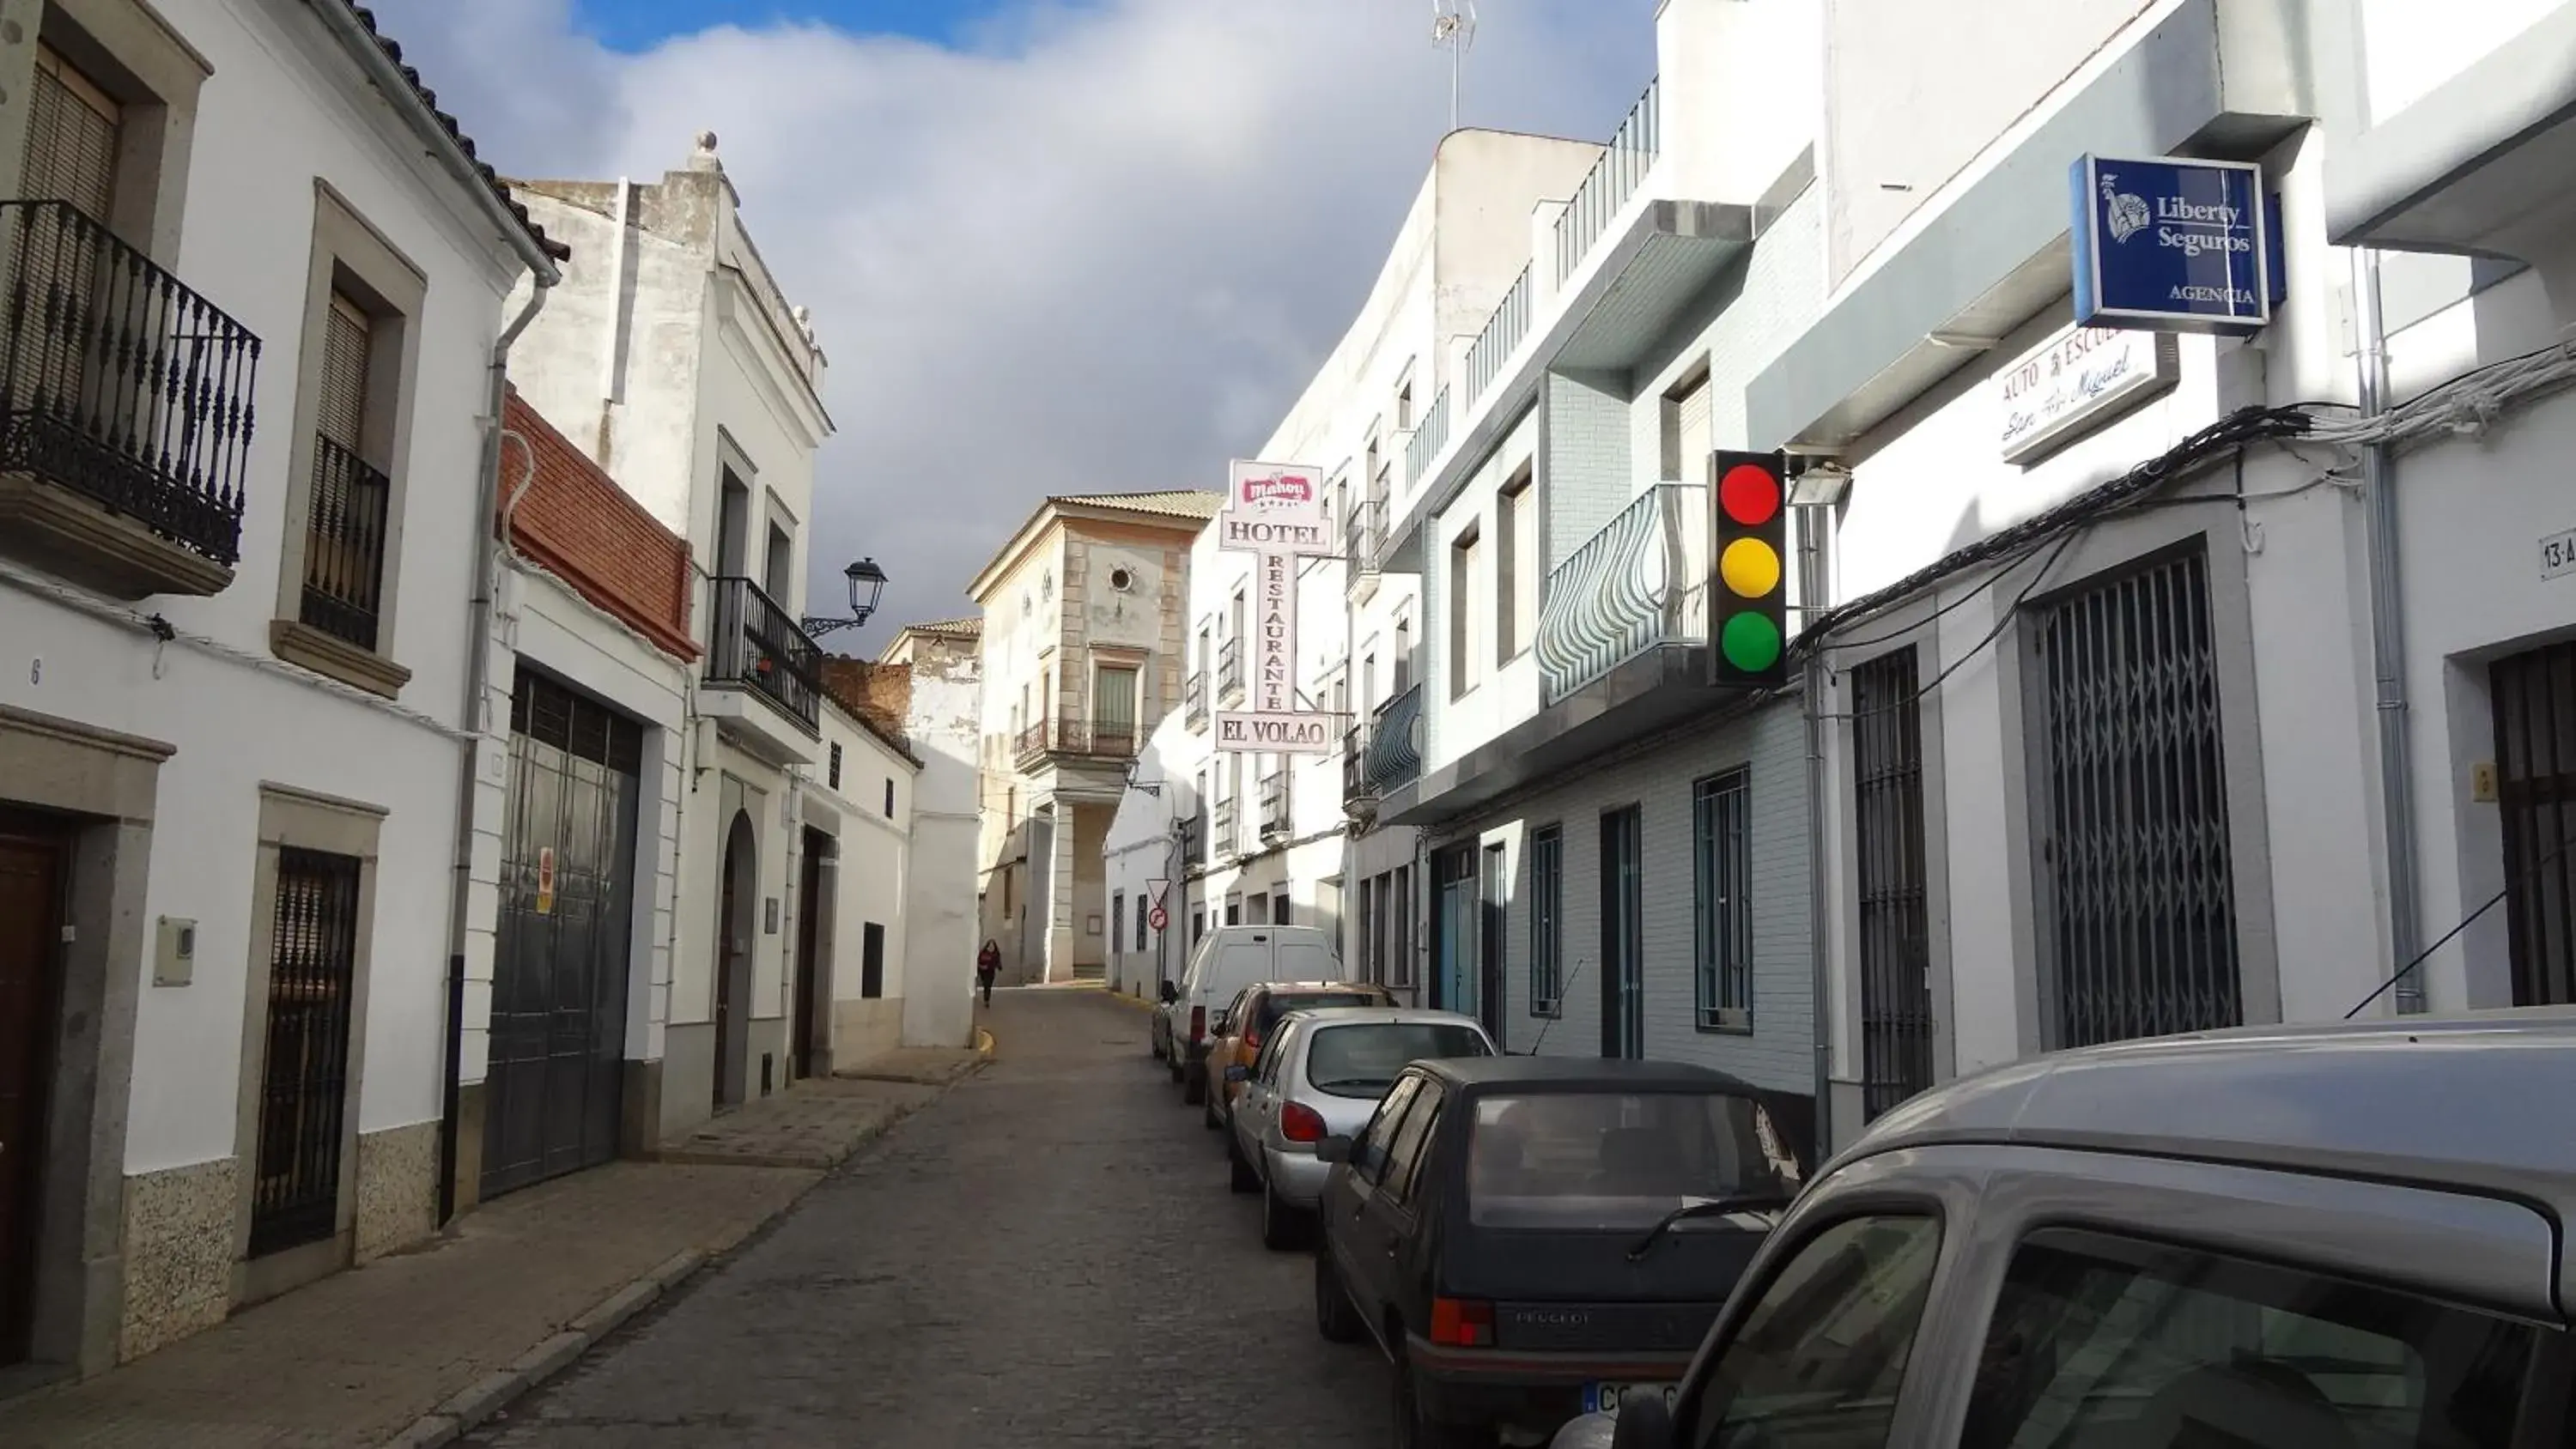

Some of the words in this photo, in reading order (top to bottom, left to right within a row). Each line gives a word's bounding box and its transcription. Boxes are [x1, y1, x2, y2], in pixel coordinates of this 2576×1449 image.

[2156, 197, 2240, 228] Liberty
[2158, 227, 2251, 256] Seguros
[2169, 285, 2256, 304] AGENCIA
[2003, 361, 2039, 403] AUTO
[2070, 344, 2130, 403] Miguel
[1249, 481, 1305, 499] Mahou
[1229, 520, 1327, 546] HOTEL
[1264, 555, 1285, 710] RESTAURANTE
[30, 658, 41, 685] 6
[1222, 719, 1248, 743] EL
[1252, 721, 1325, 745] VOLAO
